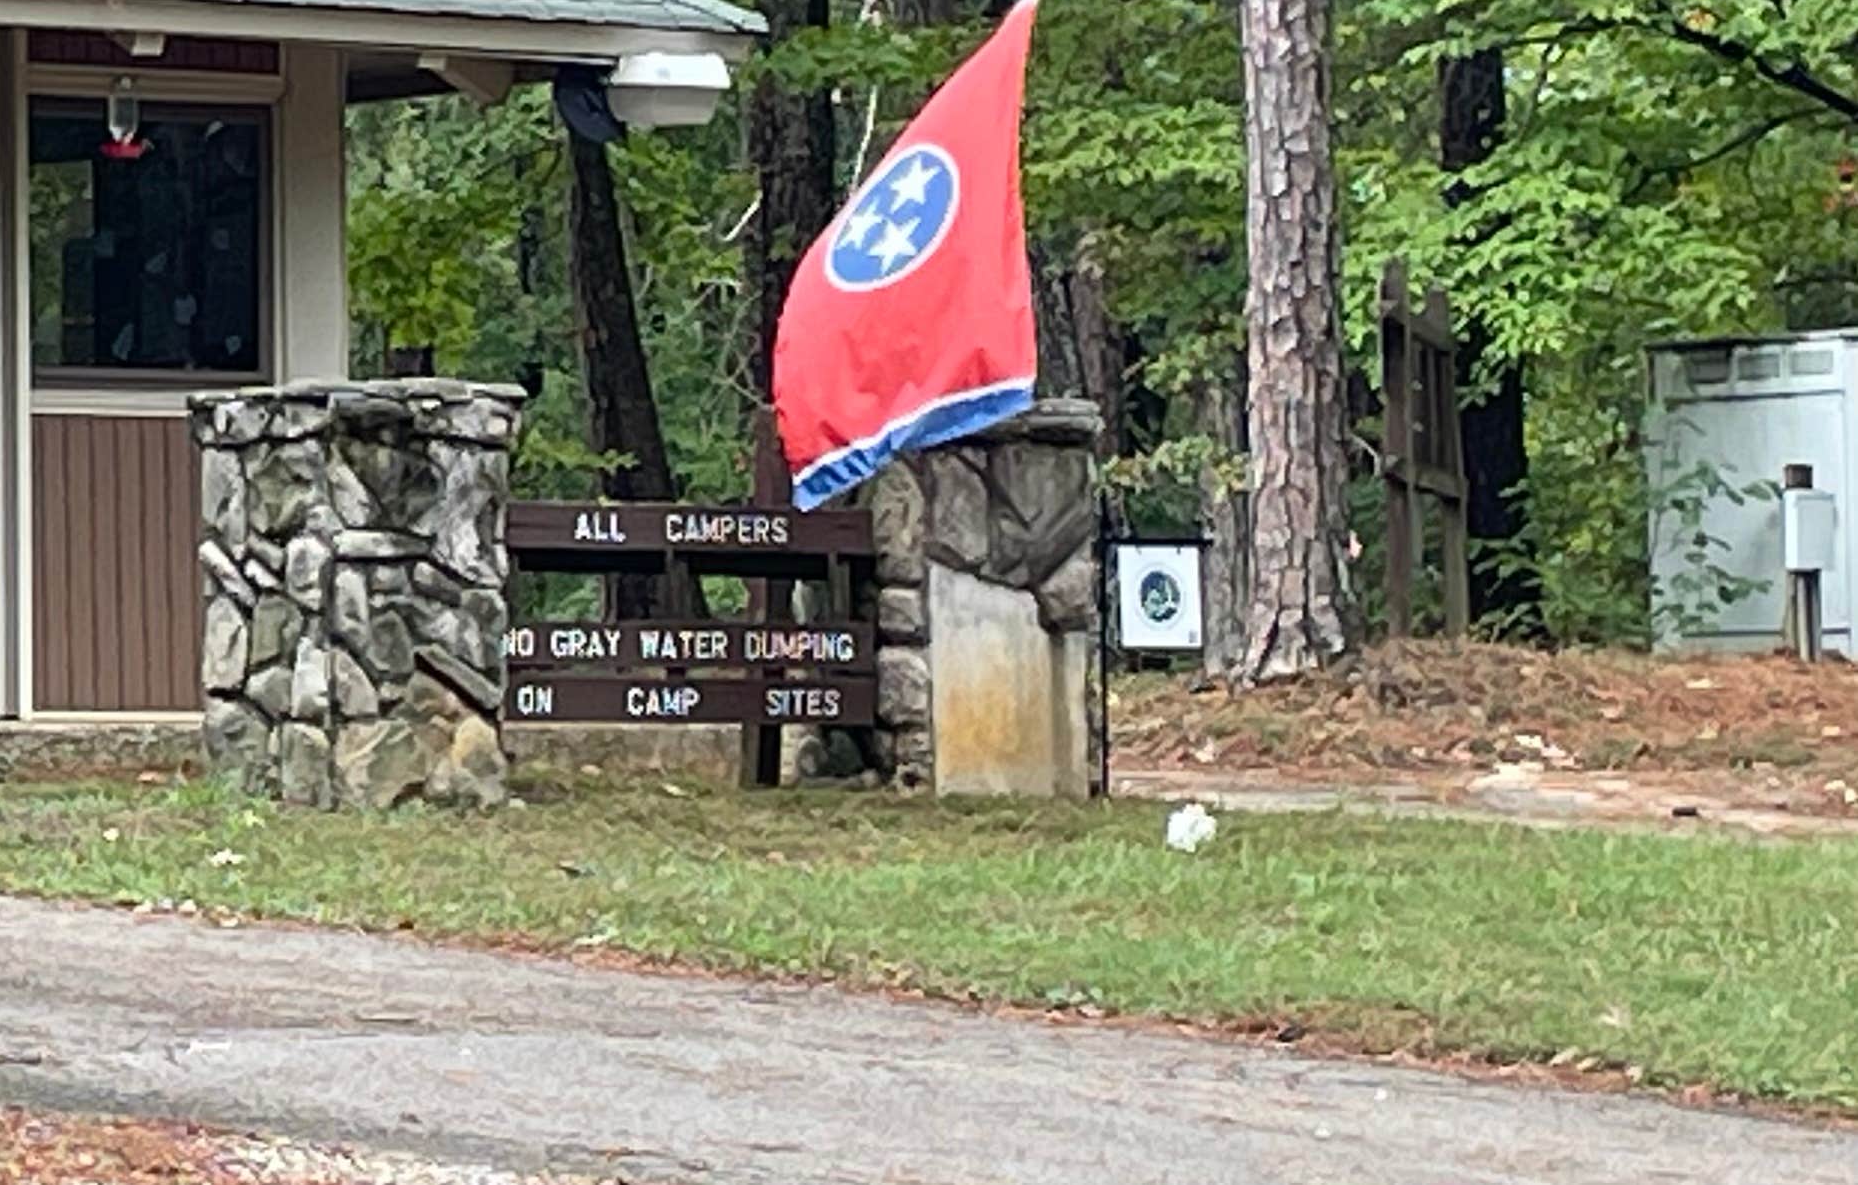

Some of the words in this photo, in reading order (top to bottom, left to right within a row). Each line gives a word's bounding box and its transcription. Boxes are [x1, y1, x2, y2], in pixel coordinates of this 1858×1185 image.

[574, 512, 627, 542] ALL
[665, 513, 788, 544] CAMPERS
[501, 628, 534, 657] NO
[550, 629, 621, 658] GRAY
[640, 630, 727, 659] WATER
[744, 630, 854, 661] DUMPING
[517, 685, 553, 715] ON
[627, 688, 701, 716] CAMP
[765, 688, 841, 716] SITES
